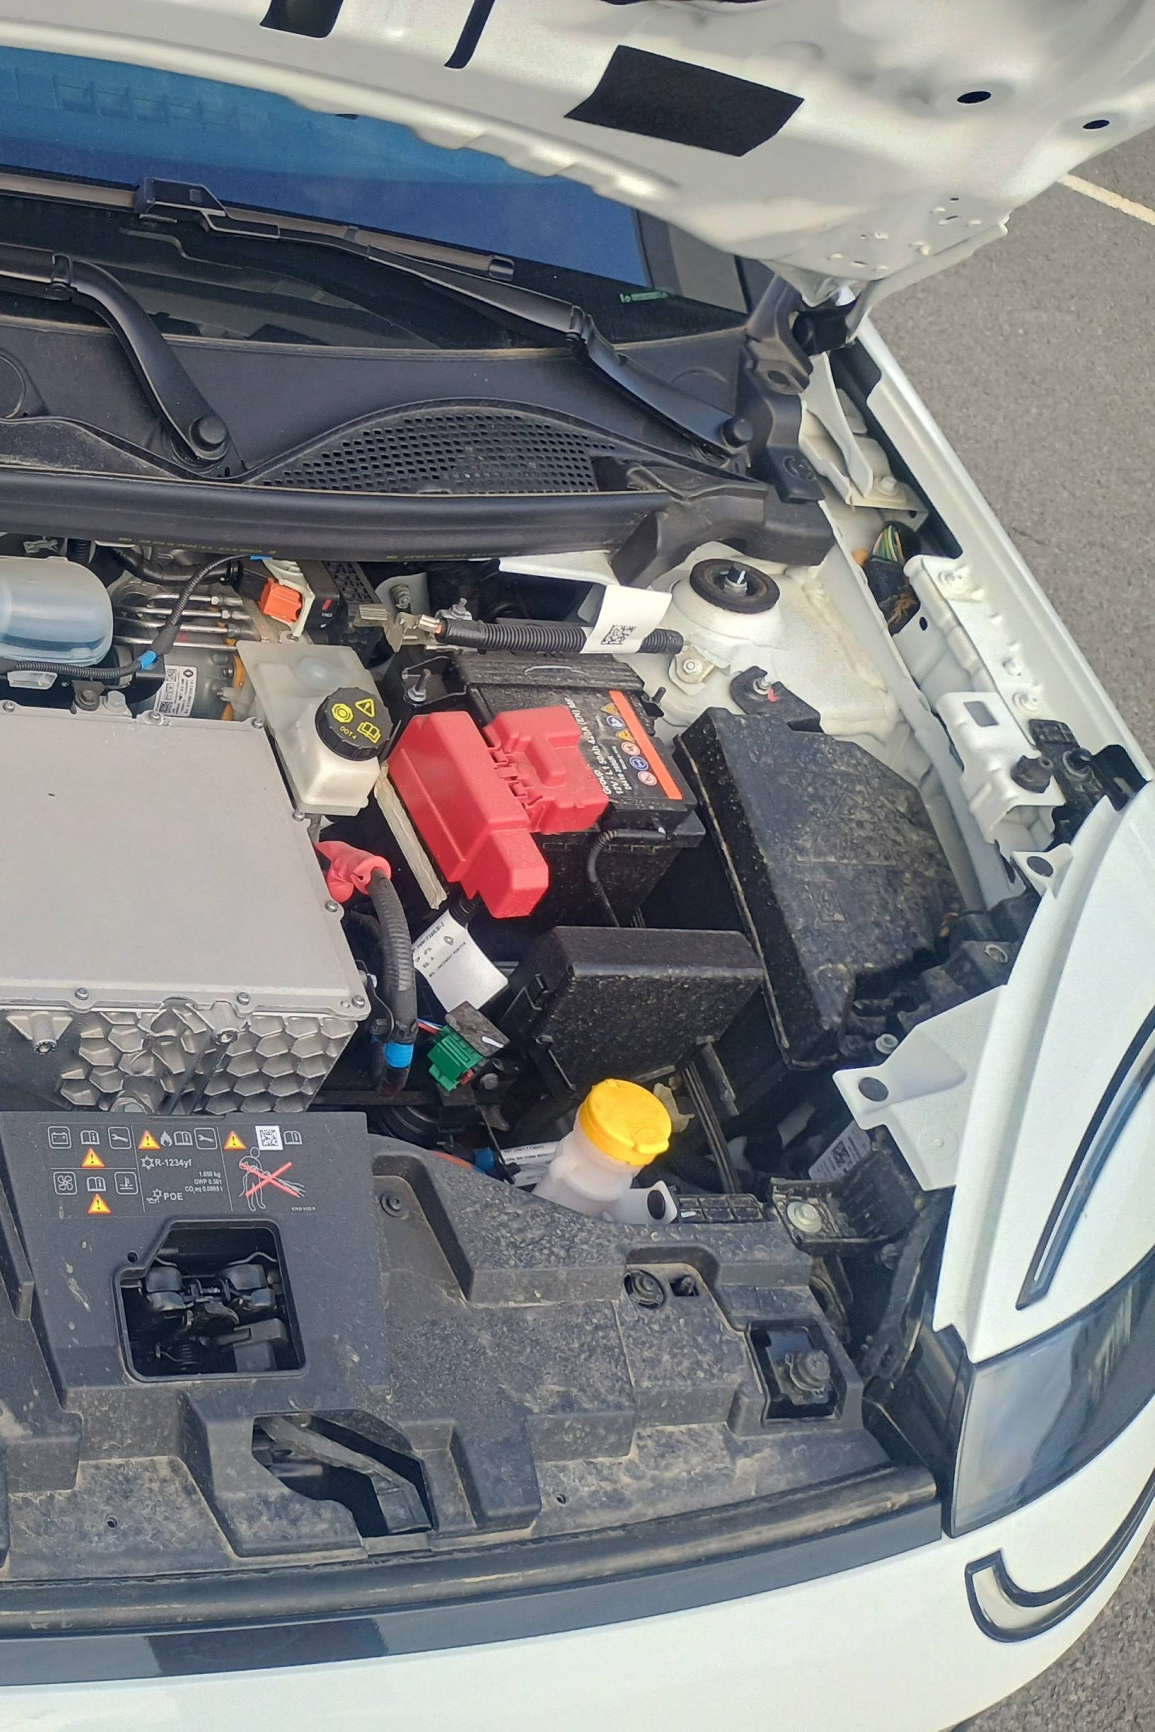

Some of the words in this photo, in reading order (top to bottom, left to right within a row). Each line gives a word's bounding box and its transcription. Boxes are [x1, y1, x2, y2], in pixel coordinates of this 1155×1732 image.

[340, 726, 353, 736] DOT
[594, 769, 612, 795] Group
[154, 1159, 192, 1168] R-1234yf
[163, 1192, 184, 1200] POE
